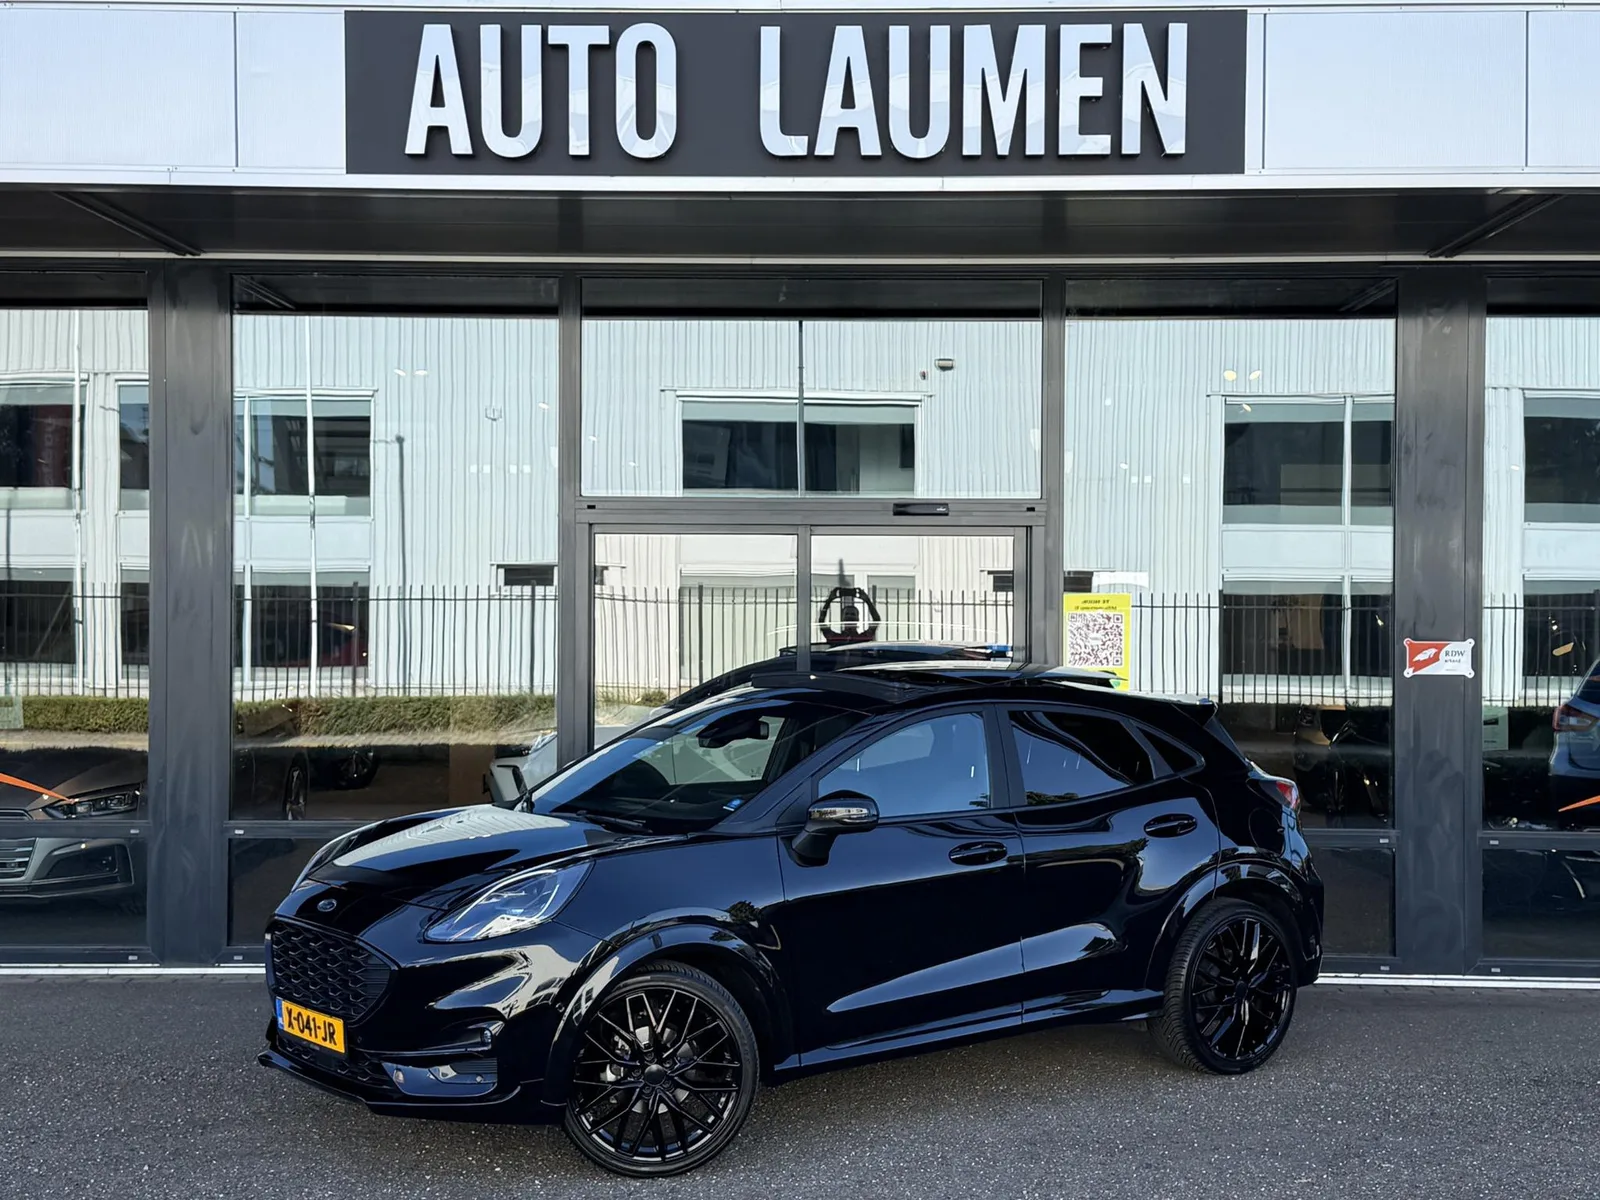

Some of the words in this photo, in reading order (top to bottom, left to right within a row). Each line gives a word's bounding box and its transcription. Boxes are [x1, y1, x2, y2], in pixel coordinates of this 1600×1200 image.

[404, 22, 678, 158] AUTO
[759, 22, 1188, 158] LAUMEN
[1444, 649, 1466, 657] RDW
[286, 1006, 337, 1046] X-041-JR
